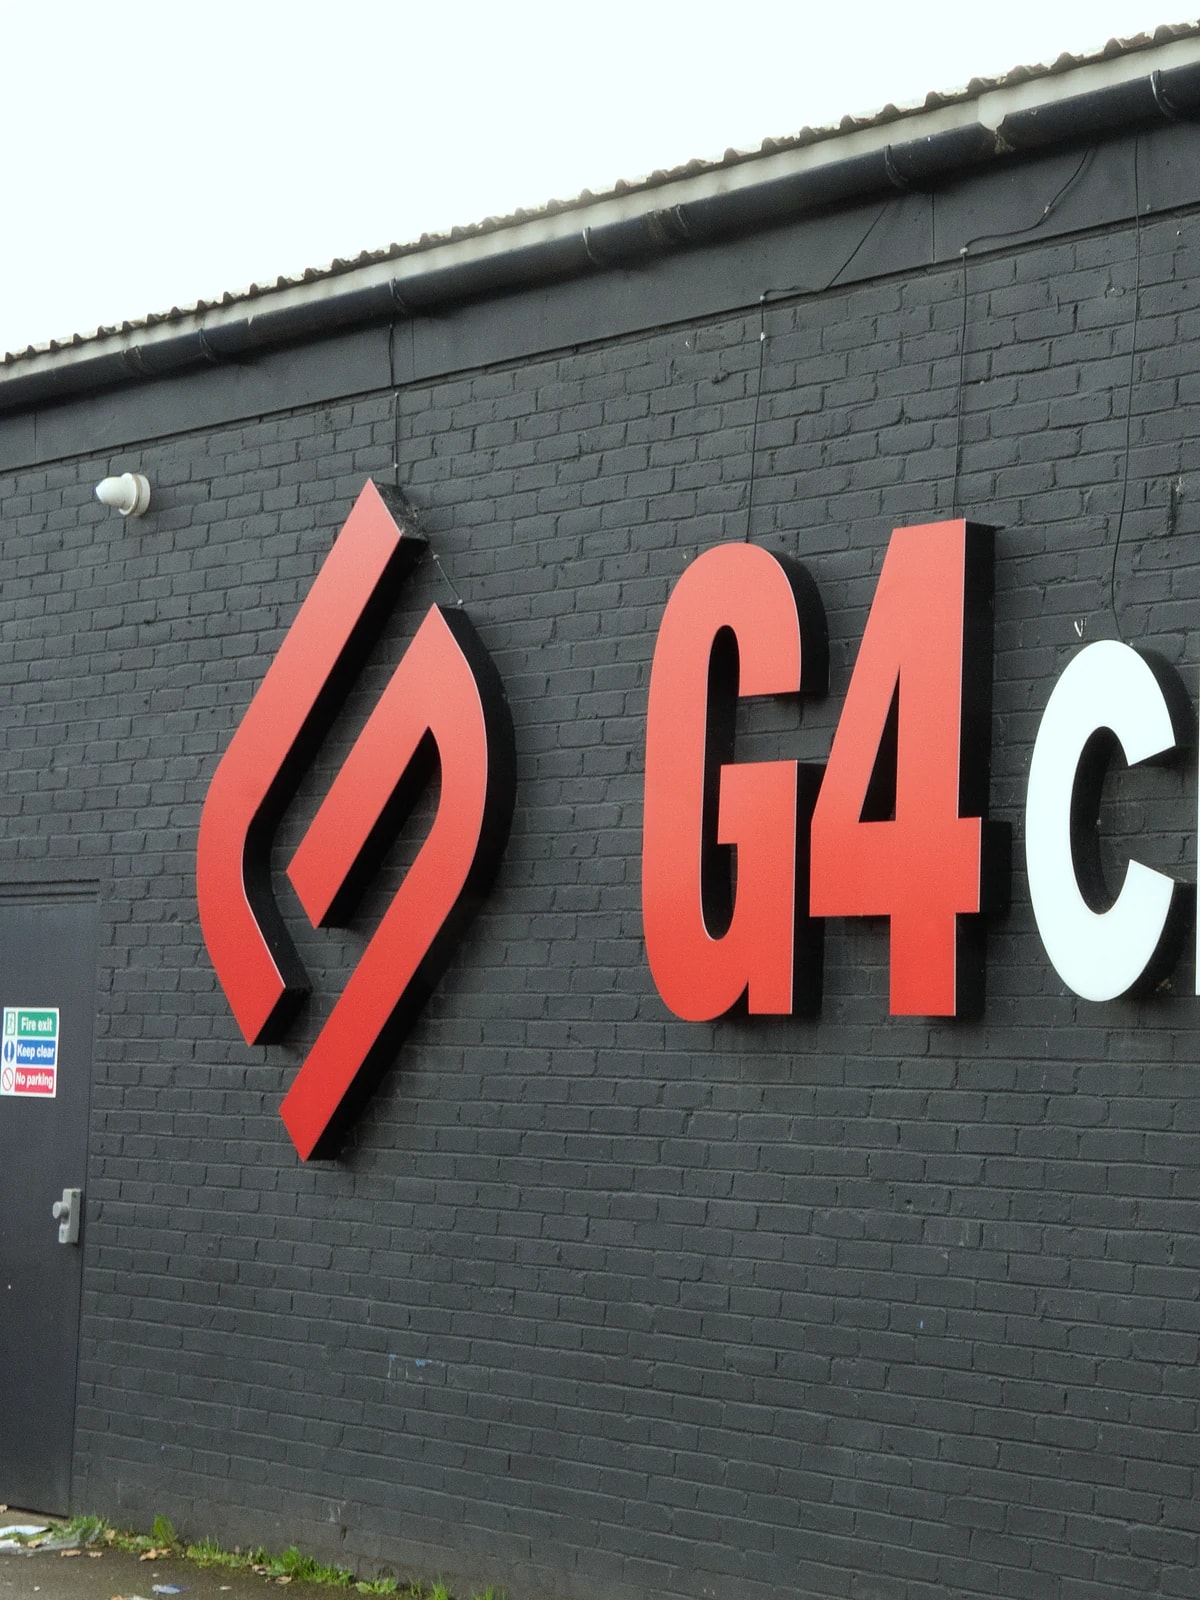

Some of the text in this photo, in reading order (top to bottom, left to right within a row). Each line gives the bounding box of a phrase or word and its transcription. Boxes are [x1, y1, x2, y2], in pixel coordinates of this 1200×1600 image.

[642, 518, 982, 1022] G4
[21, 1016, 53, 1032] Fire exit
[17, 1043, 55, 1060] Keep clear
[16, 1071, 54, 1090] No parking
